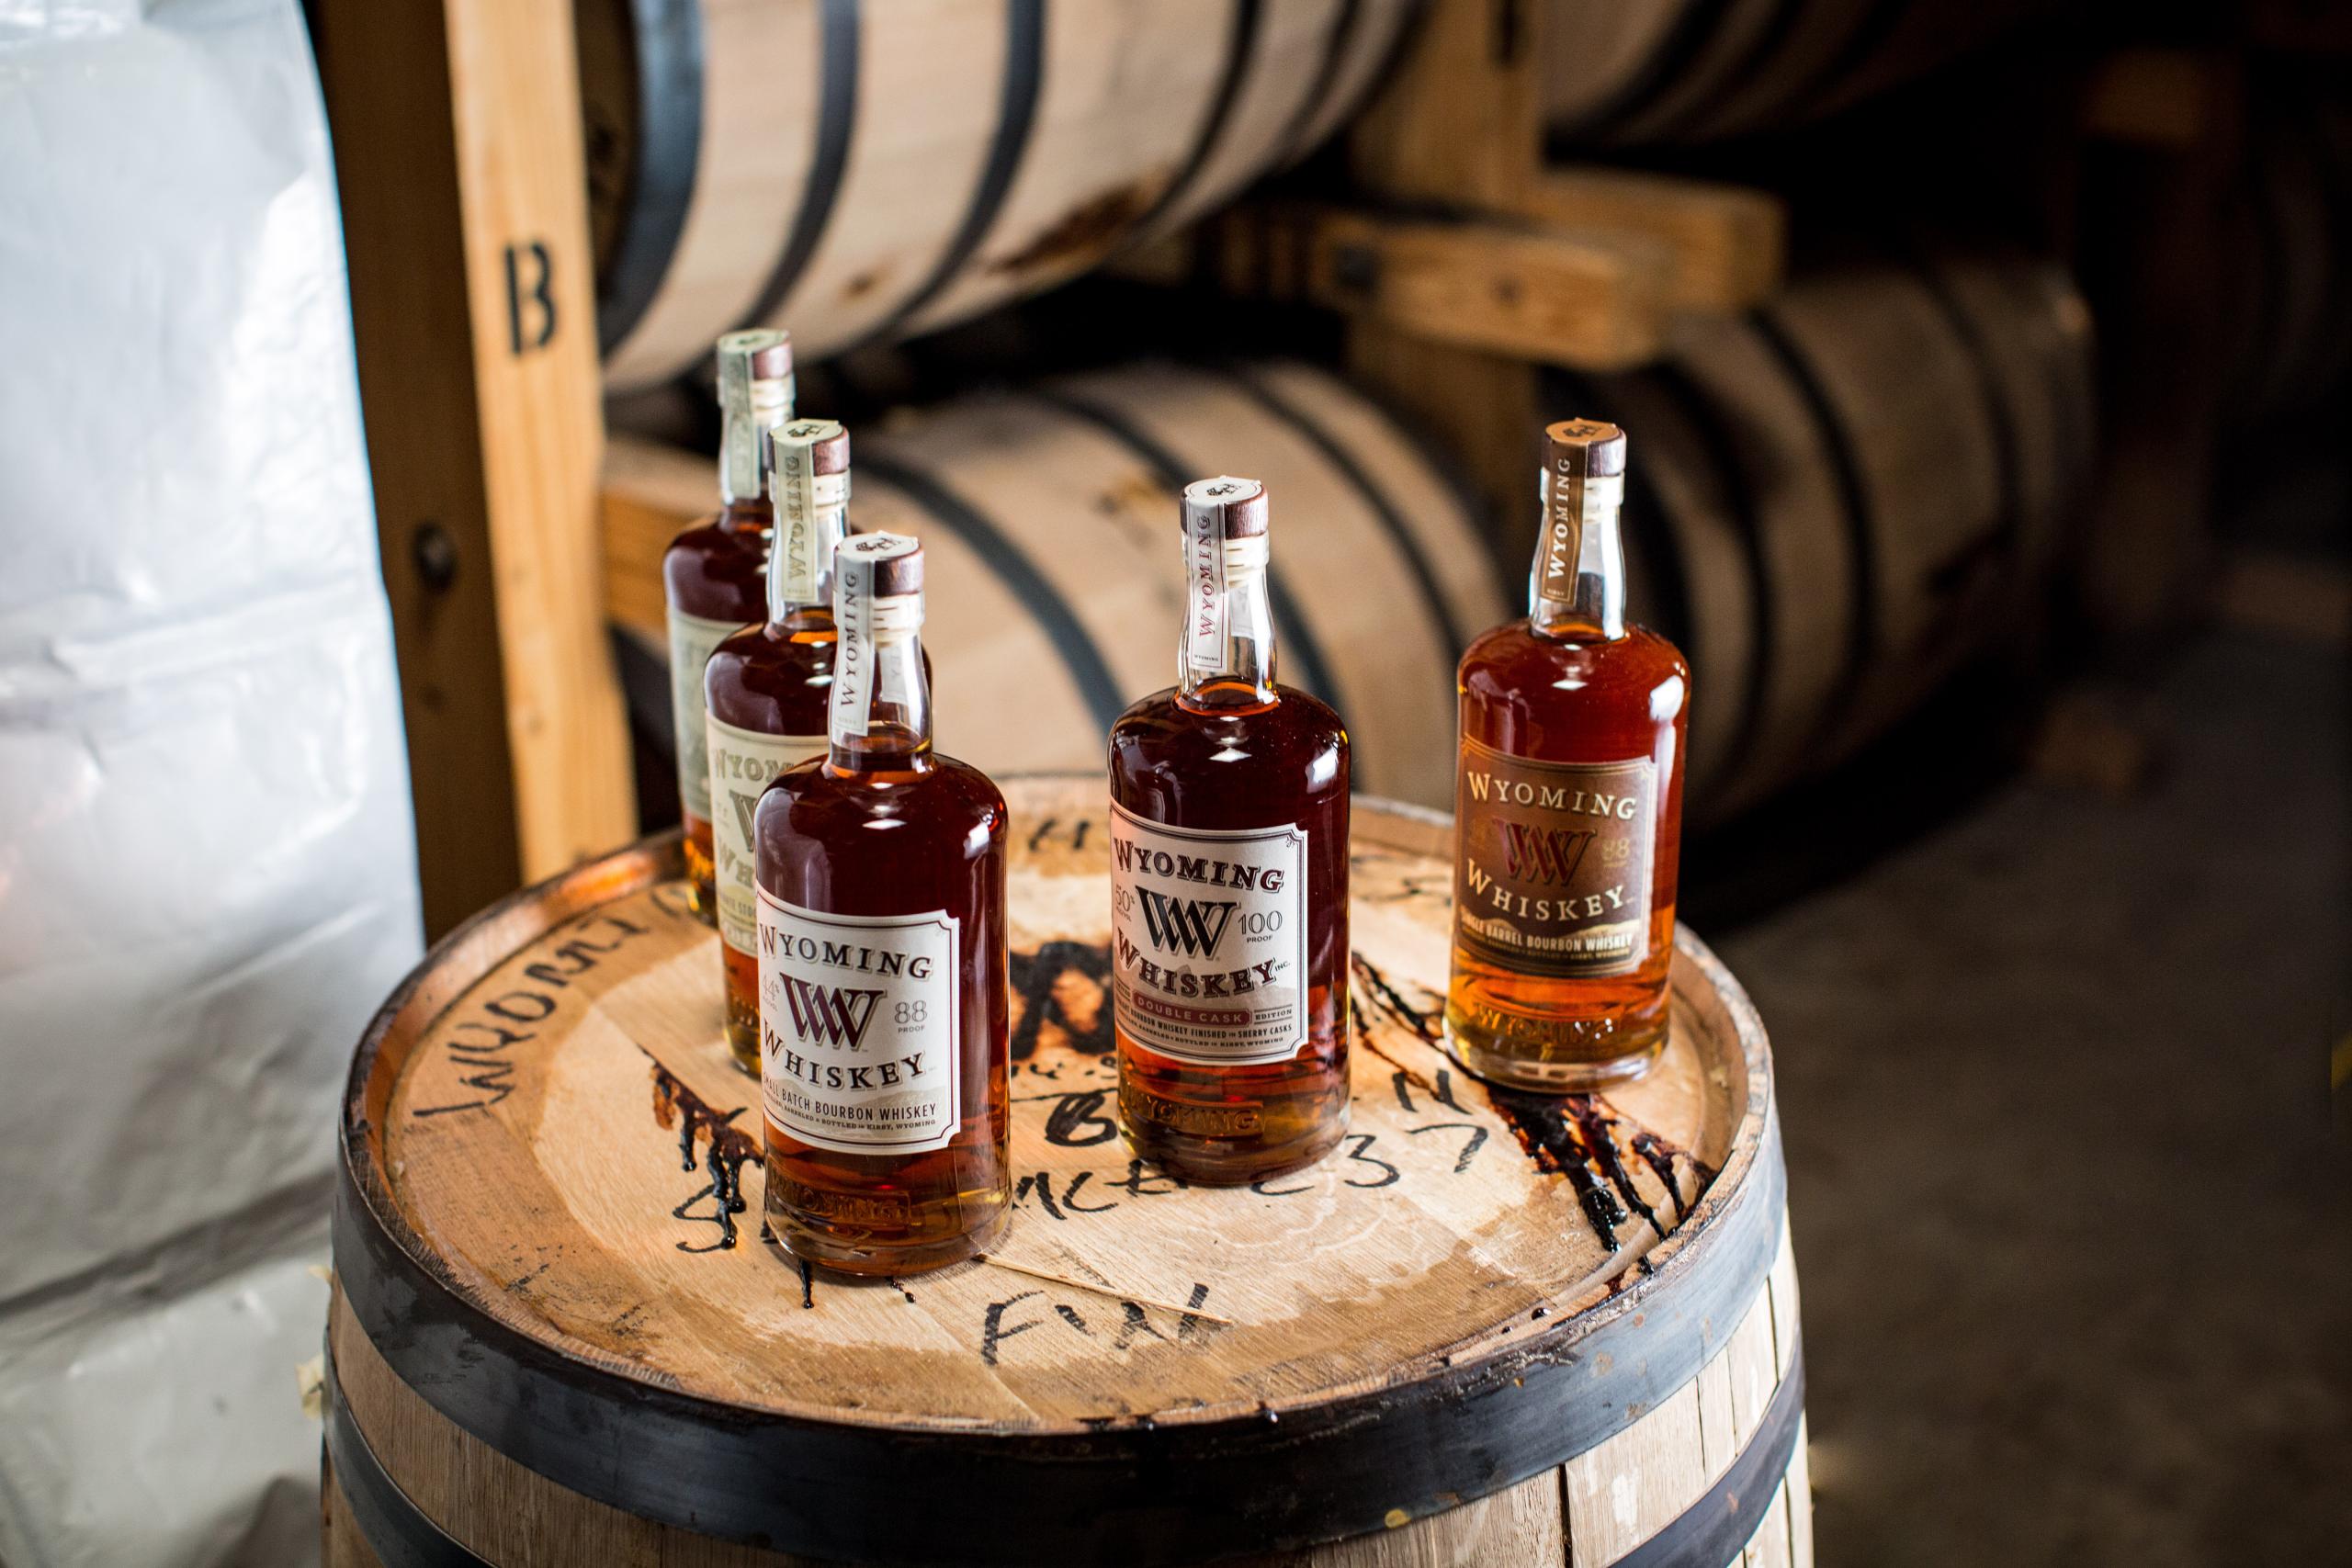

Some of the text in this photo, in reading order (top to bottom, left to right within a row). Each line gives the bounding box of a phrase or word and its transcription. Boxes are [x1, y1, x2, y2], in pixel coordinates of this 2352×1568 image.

[505, 243, 556, 355] B
[786, 456, 807, 581] WYOMING
[1546, 458, 1571, 580] WYOMING
[1197, 515, 1216, 638] WYOMING
[841, 572, 859, 706] WYOMING
[1467, 771, 1637, 820] WYOMING
[1114, 837, 1284, 894] WYOMING
[1467, 857, 1624, 921] WHISKEY
[1238, 910, 1283, 936] 100
[1246, 934, 1273, 944] PROOF
[1486, 924, 1523, 947] BARREL
[1526, 935, 1581, 953] BOURBON
[1585, 932, 1633, 953] WHISKEY
[759, 923, 933, 980] WYOMING
[1117, 926, 1277, 998] WHISKEY
[894, 999, 928, 1025] 88
[898, 1023, 926, 1033] PROOF
[1137, 997, 1193, 1021] DOUBLE
[1199, 1012, 1243, 1024] CASK
[1255, 1008, 1293, 1021] EDITION
[1158, 1021, 1189, 1035] WHISKEY
[1191, 1028, 1227, 1039] FINISHED
[1238, 1028, 1268, 1039] SHERRY
[1270, 1023, 1293, 1035] CASKS
[763, 1017, 926, 1091] WHISKEY
[782, 1088, 810, 1111] BATCH
[815, 1100, 873, 1122] BOURBON
[879, 1102, 936, 1122] WHISKEY
[821, 1118, 858, 1130] BOTTLED
[896, 1119, 936, 1130] WYOMING
